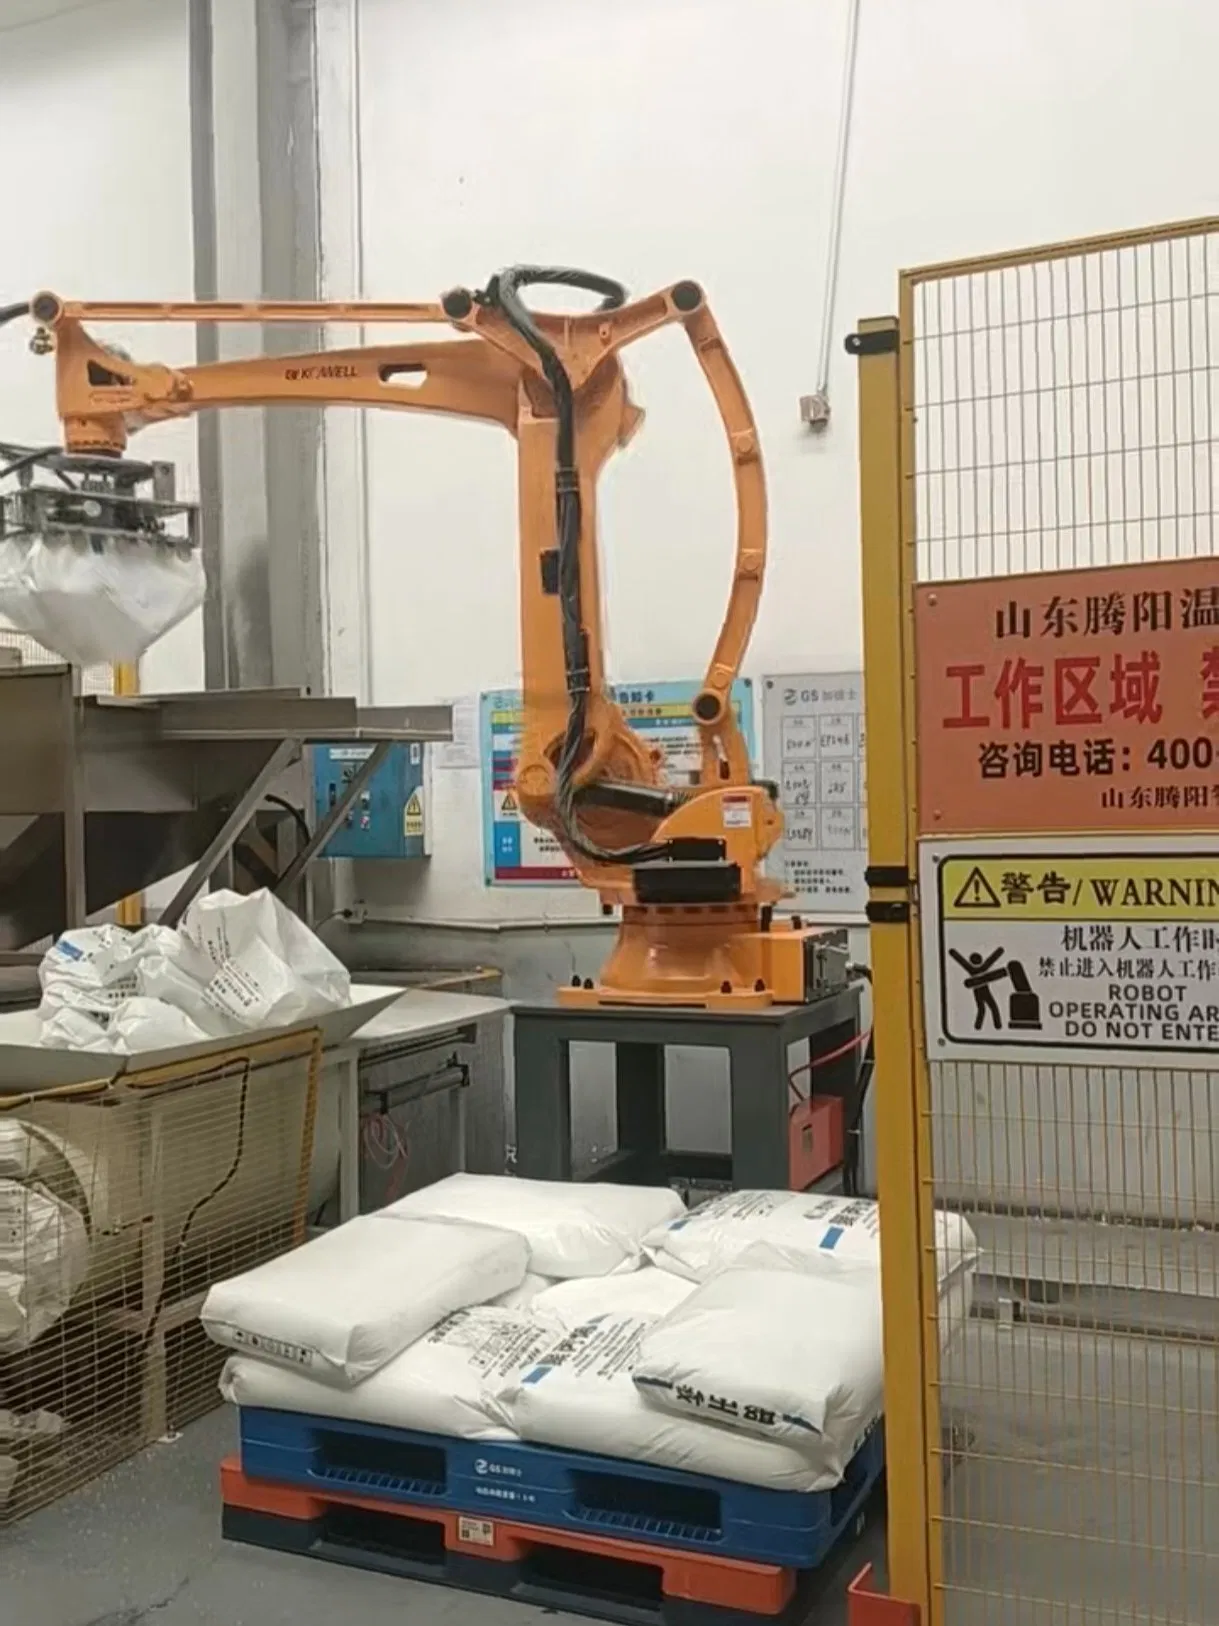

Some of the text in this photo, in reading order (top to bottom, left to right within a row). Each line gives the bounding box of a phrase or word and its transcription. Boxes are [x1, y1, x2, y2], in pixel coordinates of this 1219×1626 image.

[996, 586, 1219, 638] 山东腾阳温
[943, 650, 1163, 729] 工作区域
[1038, 956, 1219, 981] 禁止进入机器人工作
[1108, 984, 1188, 1002] ROBOT
[1049, 1001, 1179, 1022] OPERATING
[1065, 1020, 1097, 1038] DO
[1106, 1022, 1153, 1040] NOT
